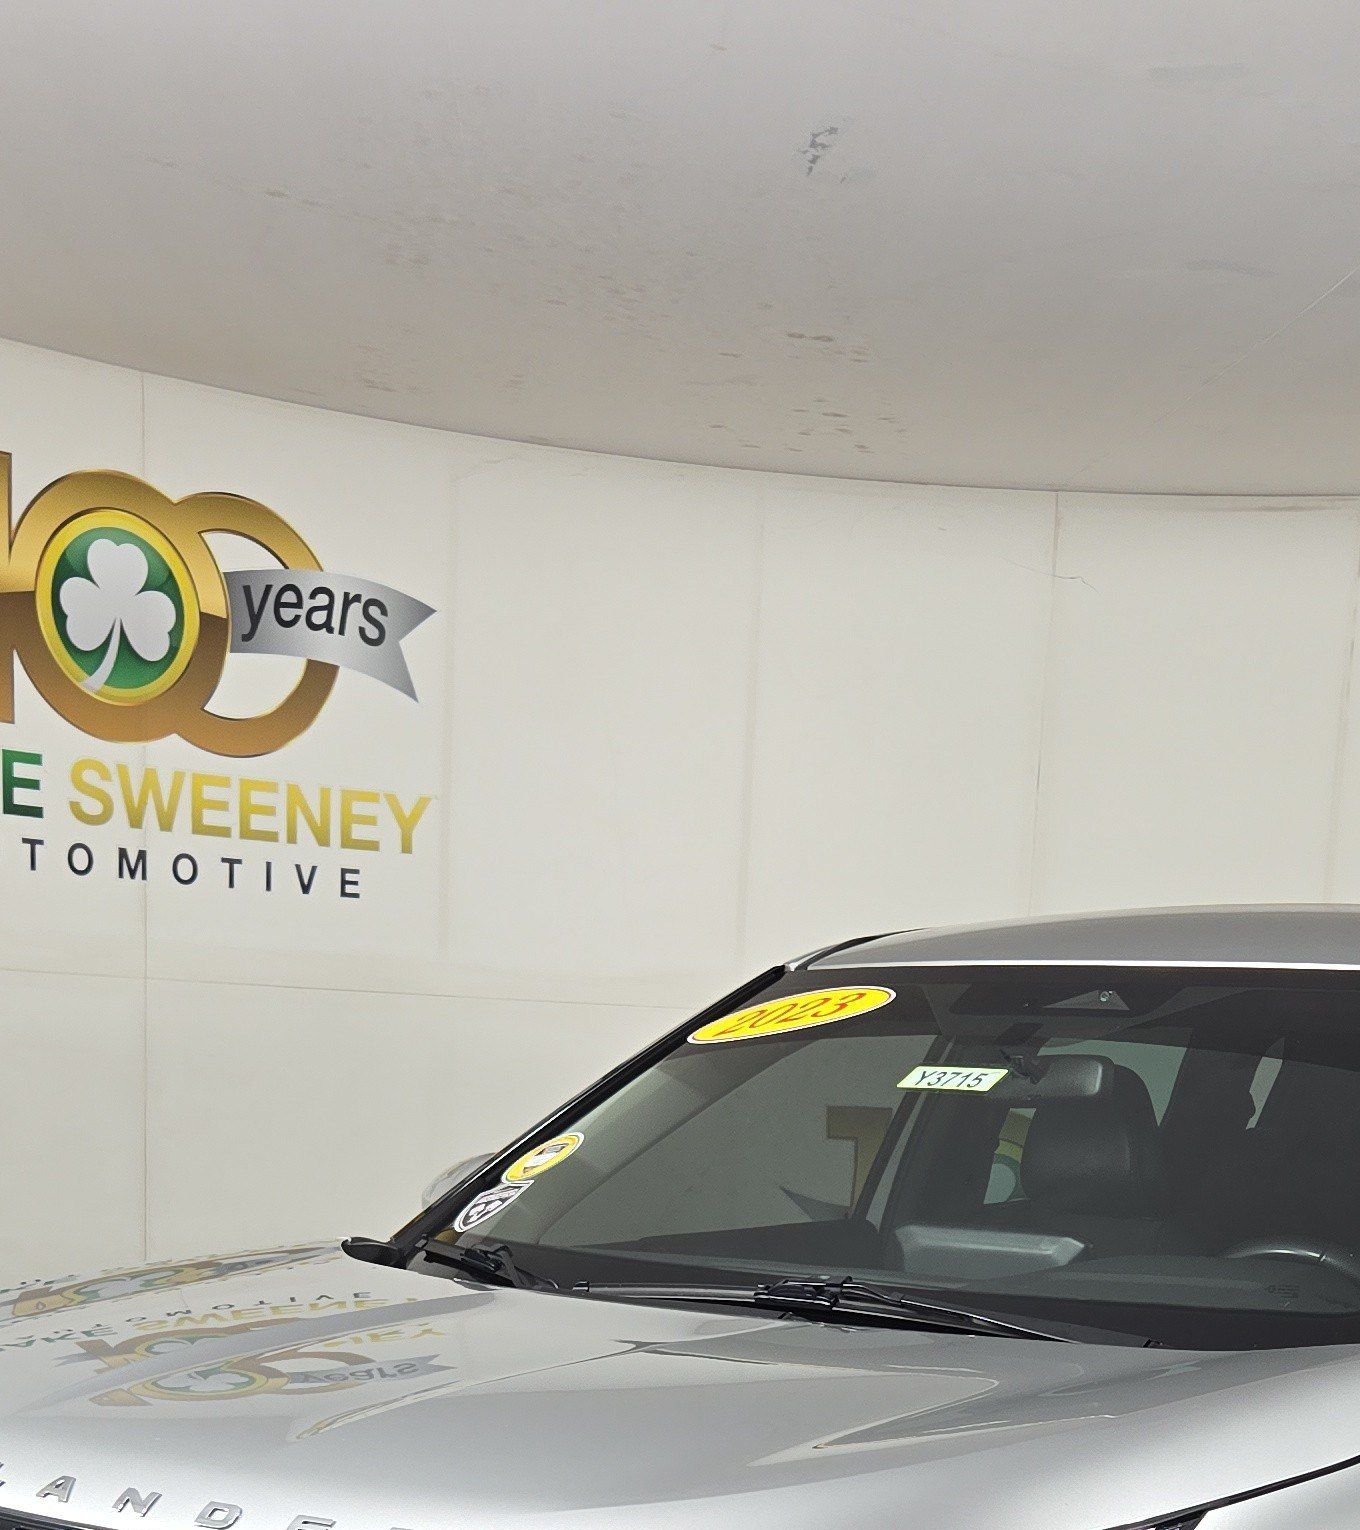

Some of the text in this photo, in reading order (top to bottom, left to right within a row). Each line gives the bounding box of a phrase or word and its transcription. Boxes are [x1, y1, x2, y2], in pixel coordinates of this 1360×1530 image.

[241, 578, 388, 648] years
[68, 757, 432, 855] SWEENEY
[712, 992, 867, 1038] 2023
[917, 1070, 989, 1088] Y3715
